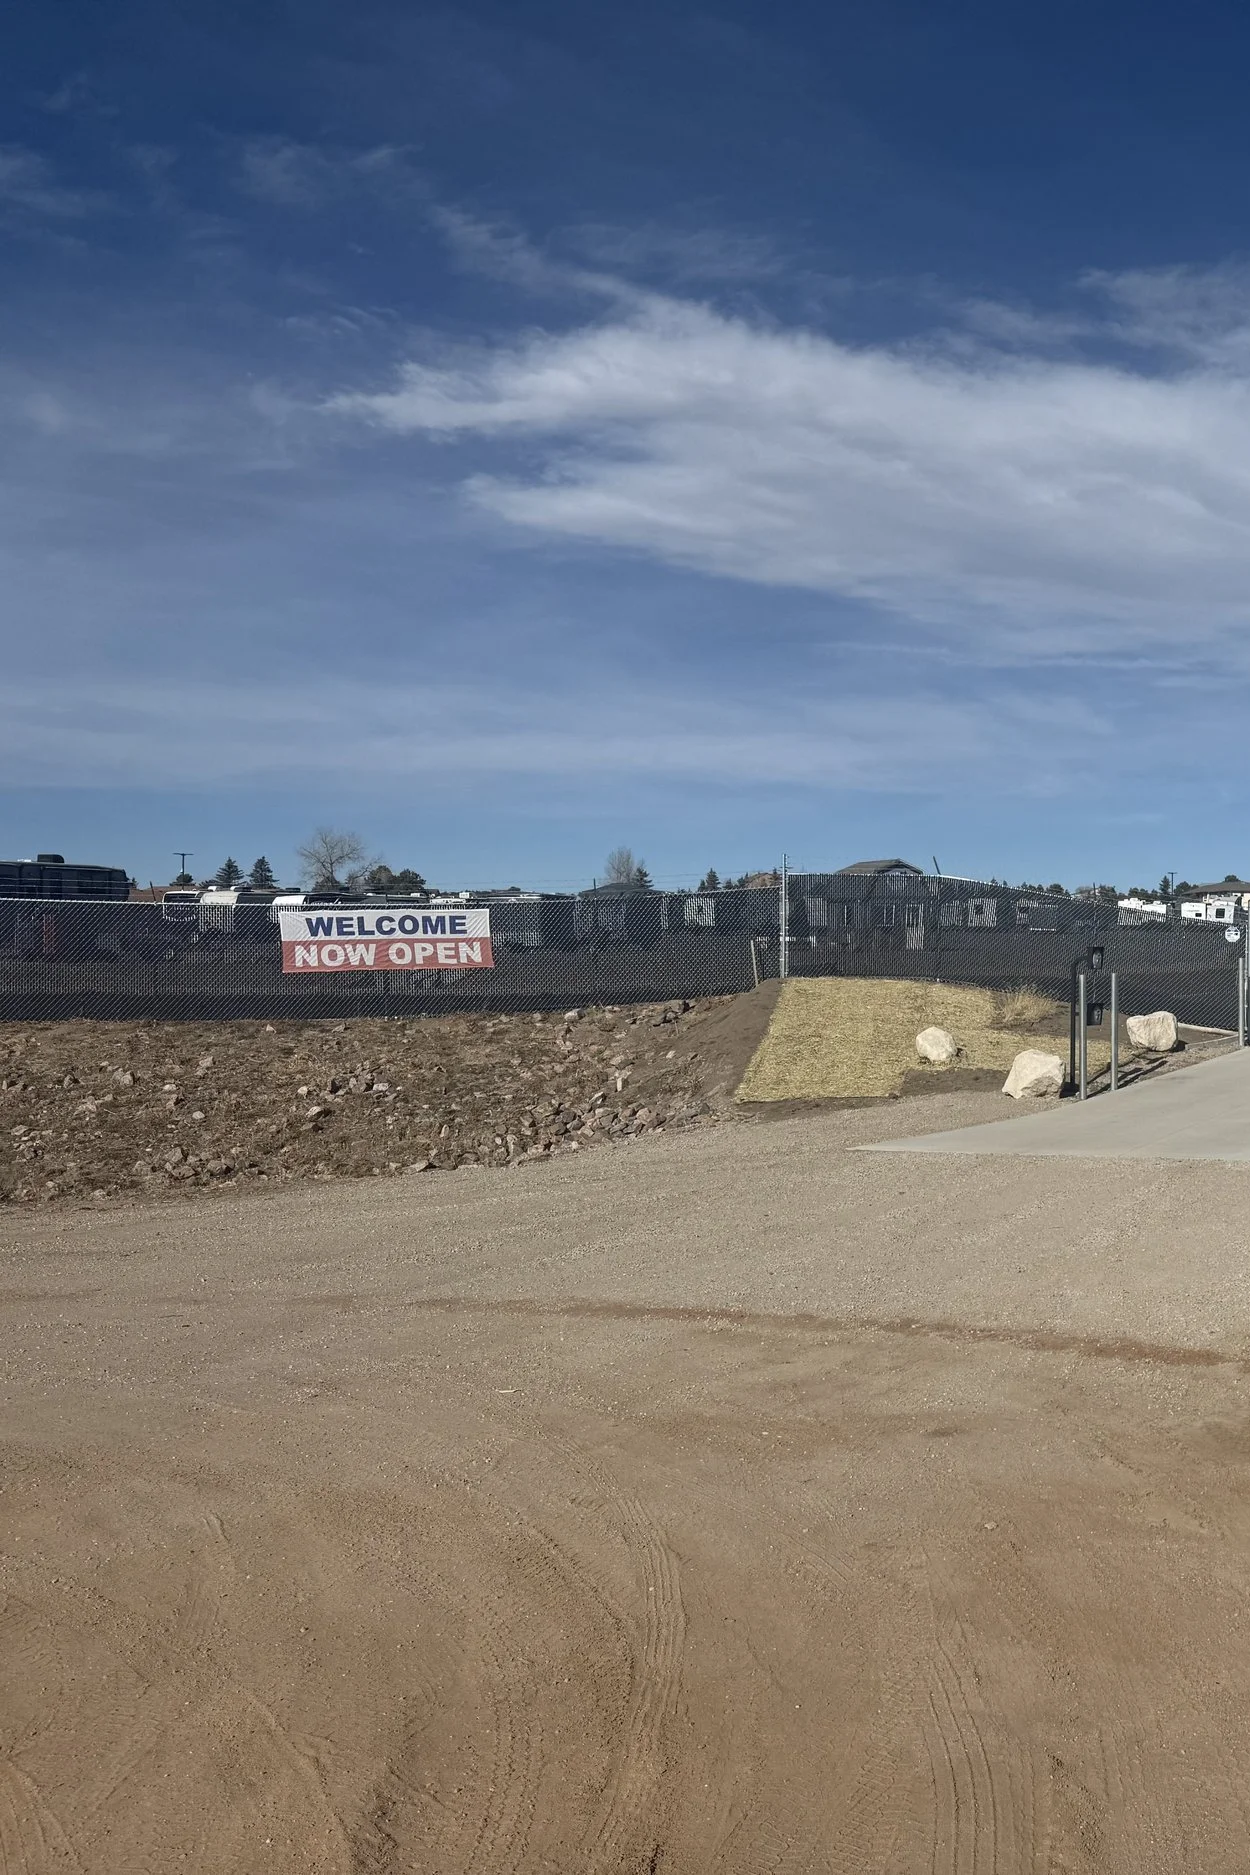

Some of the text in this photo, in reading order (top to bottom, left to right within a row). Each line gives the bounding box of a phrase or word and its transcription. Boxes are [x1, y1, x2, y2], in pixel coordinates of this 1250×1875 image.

[305, 915, 468, 937] WELCOME
[294, 941, 483, 967] NOW OPEN
